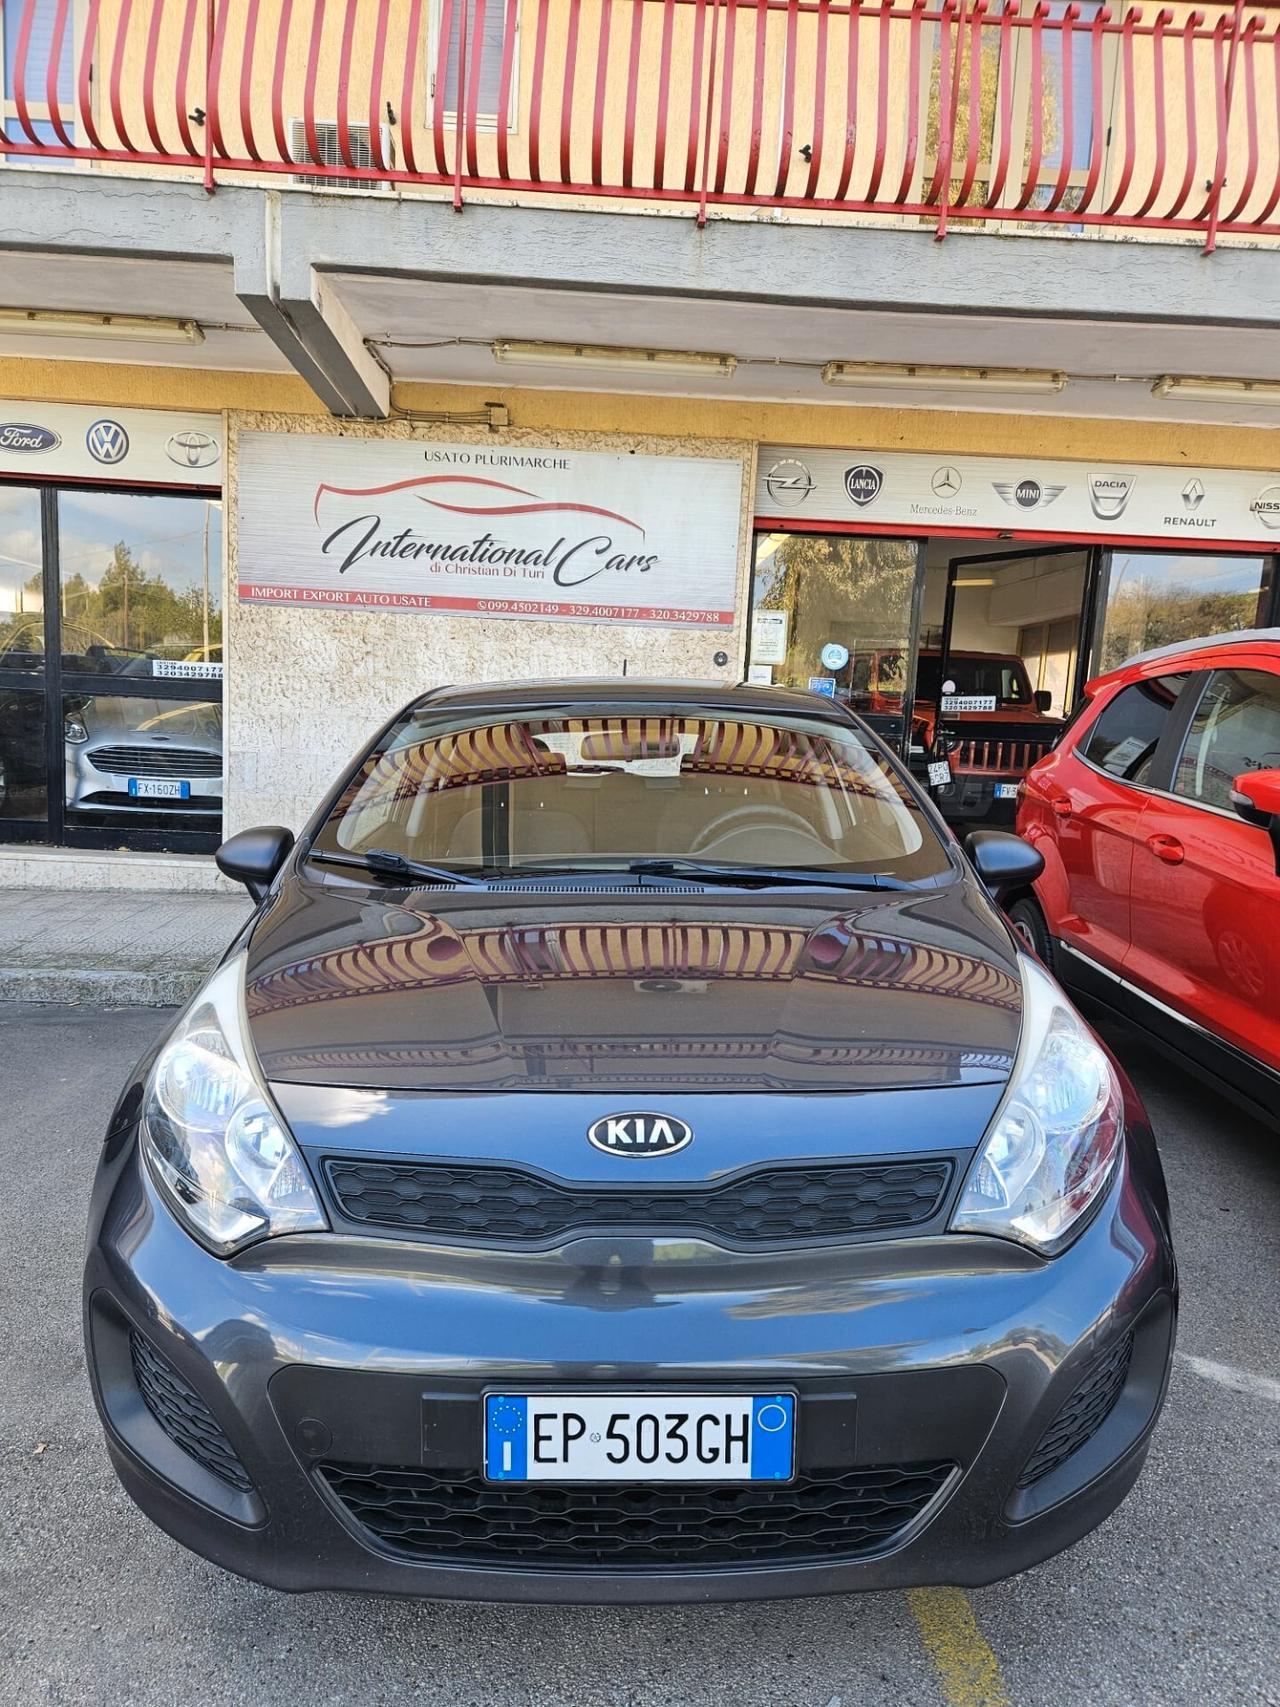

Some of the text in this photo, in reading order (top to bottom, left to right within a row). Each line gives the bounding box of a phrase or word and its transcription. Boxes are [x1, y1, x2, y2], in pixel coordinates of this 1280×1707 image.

[0, 427, 43, 448] Ford
[424, 450, 571, 470] USATO PLURIMARCHE
[850, 478, 876, 490] LANCIA
[1016, 487, 1040, 500] MINI
[1094, 480, 1128, 489] DACIA
[909, 503, 978, 517] Mercedes-Benz
[1163, 516, 1217, 527] RENAULT
[321, 514, 661, 587] International Cars
[429, 561, 545, 580] di Christian Di Turi
[251, 587, 431, 607] IMPORT EXPORT AUTO USATE
[488, 601, 559, 614] 099.4502149
[569, 605, 640, 618] 329.4007177
[649, 609, 720, 622] 320.3429788
[138, 782, 180, 796] FX 160ZH
[606, 1118, 676, 1145] KIA
[533, 1413, 750, 1464] EP 503GH
